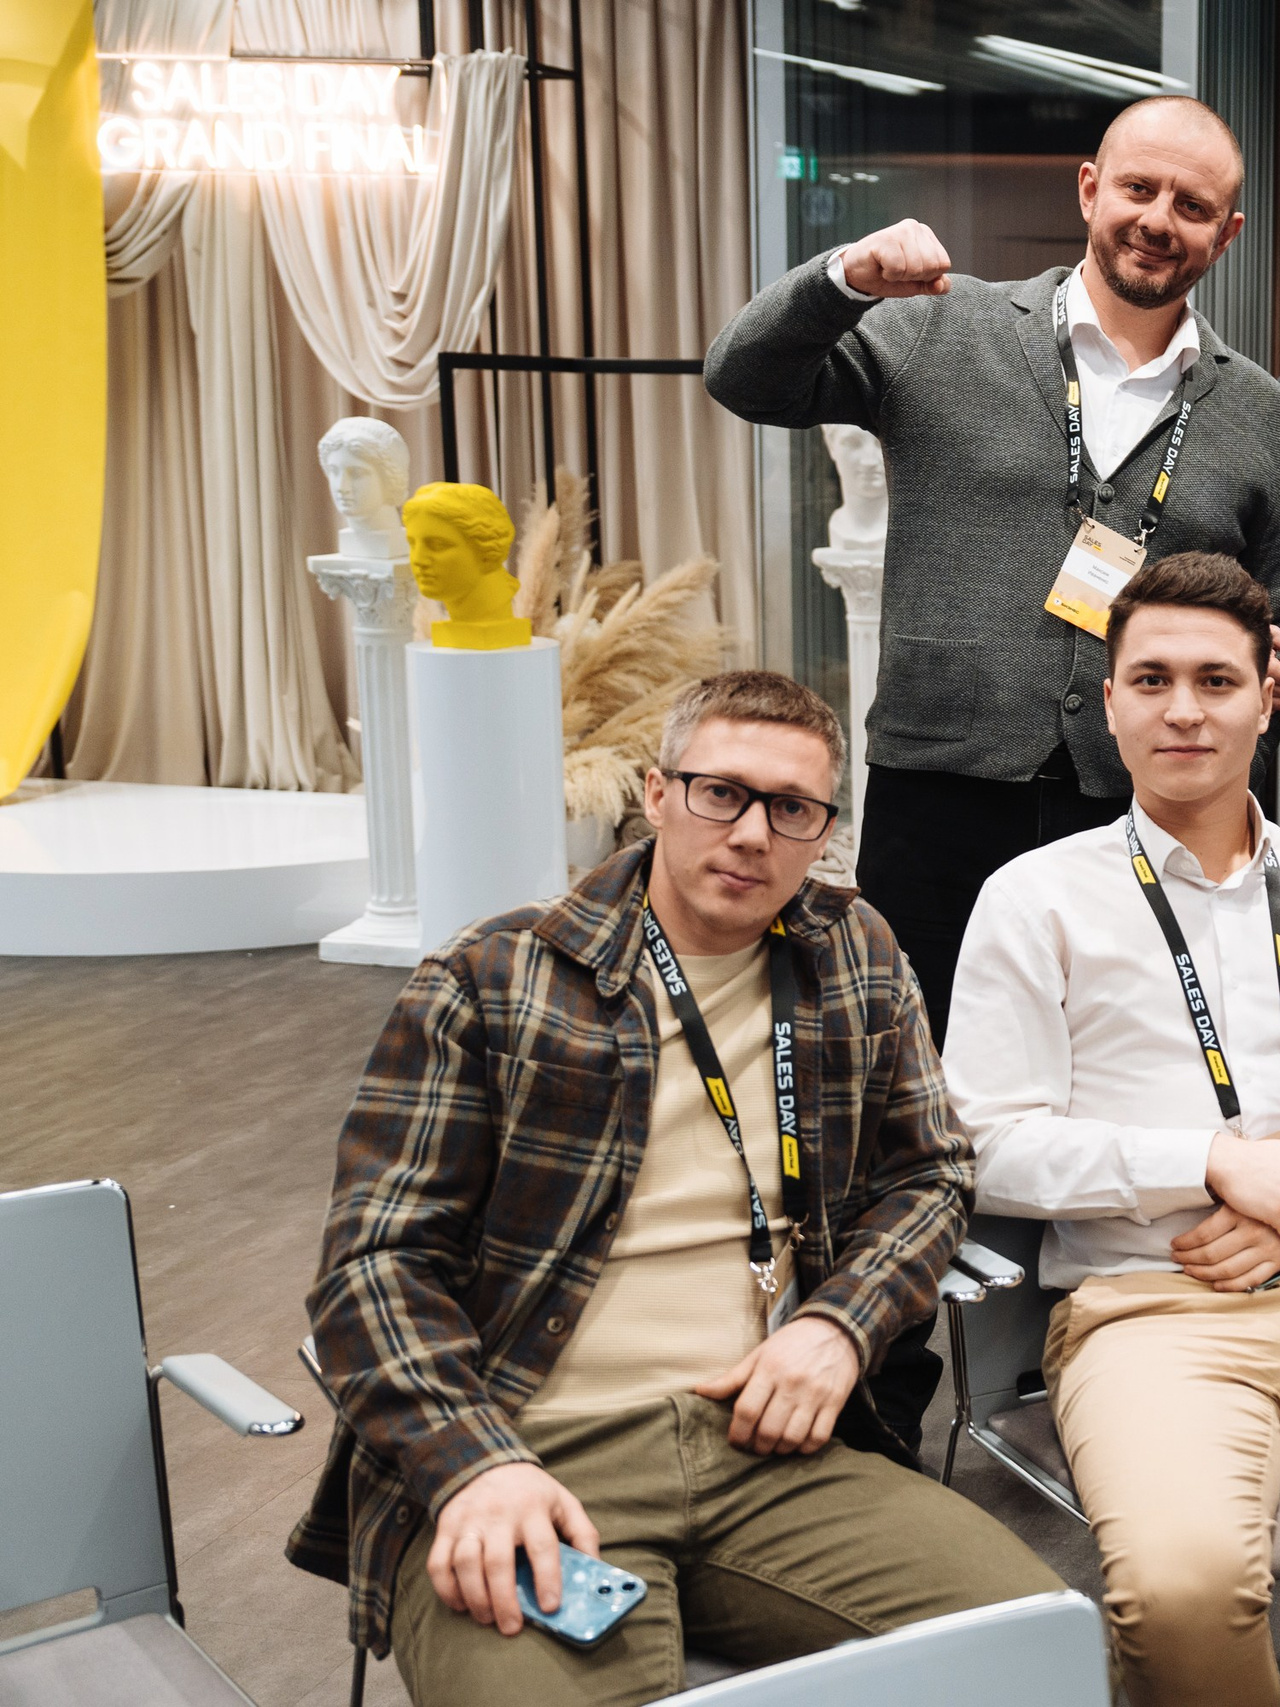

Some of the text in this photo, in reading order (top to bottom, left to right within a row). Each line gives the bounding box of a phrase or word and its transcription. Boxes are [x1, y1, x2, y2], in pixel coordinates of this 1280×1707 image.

[132, 62, 401, 116] SALES DAY
[97, 117, 439, 174] GRAND FINAL
[1068, 404, 1081, 484] SALES DAY
[1171, 401, 1192, 447] SALES
[1161, 447, 1178, 476] DAY
[644, 908, 687, 996] SALES DAY
[1175, 953, 1206, 1013] SALES
[1195, 1014, 1219, 1052] DAY
[775, 1021, 795, 1090] SALES
[778, 1095, 797, 1136] DAY
